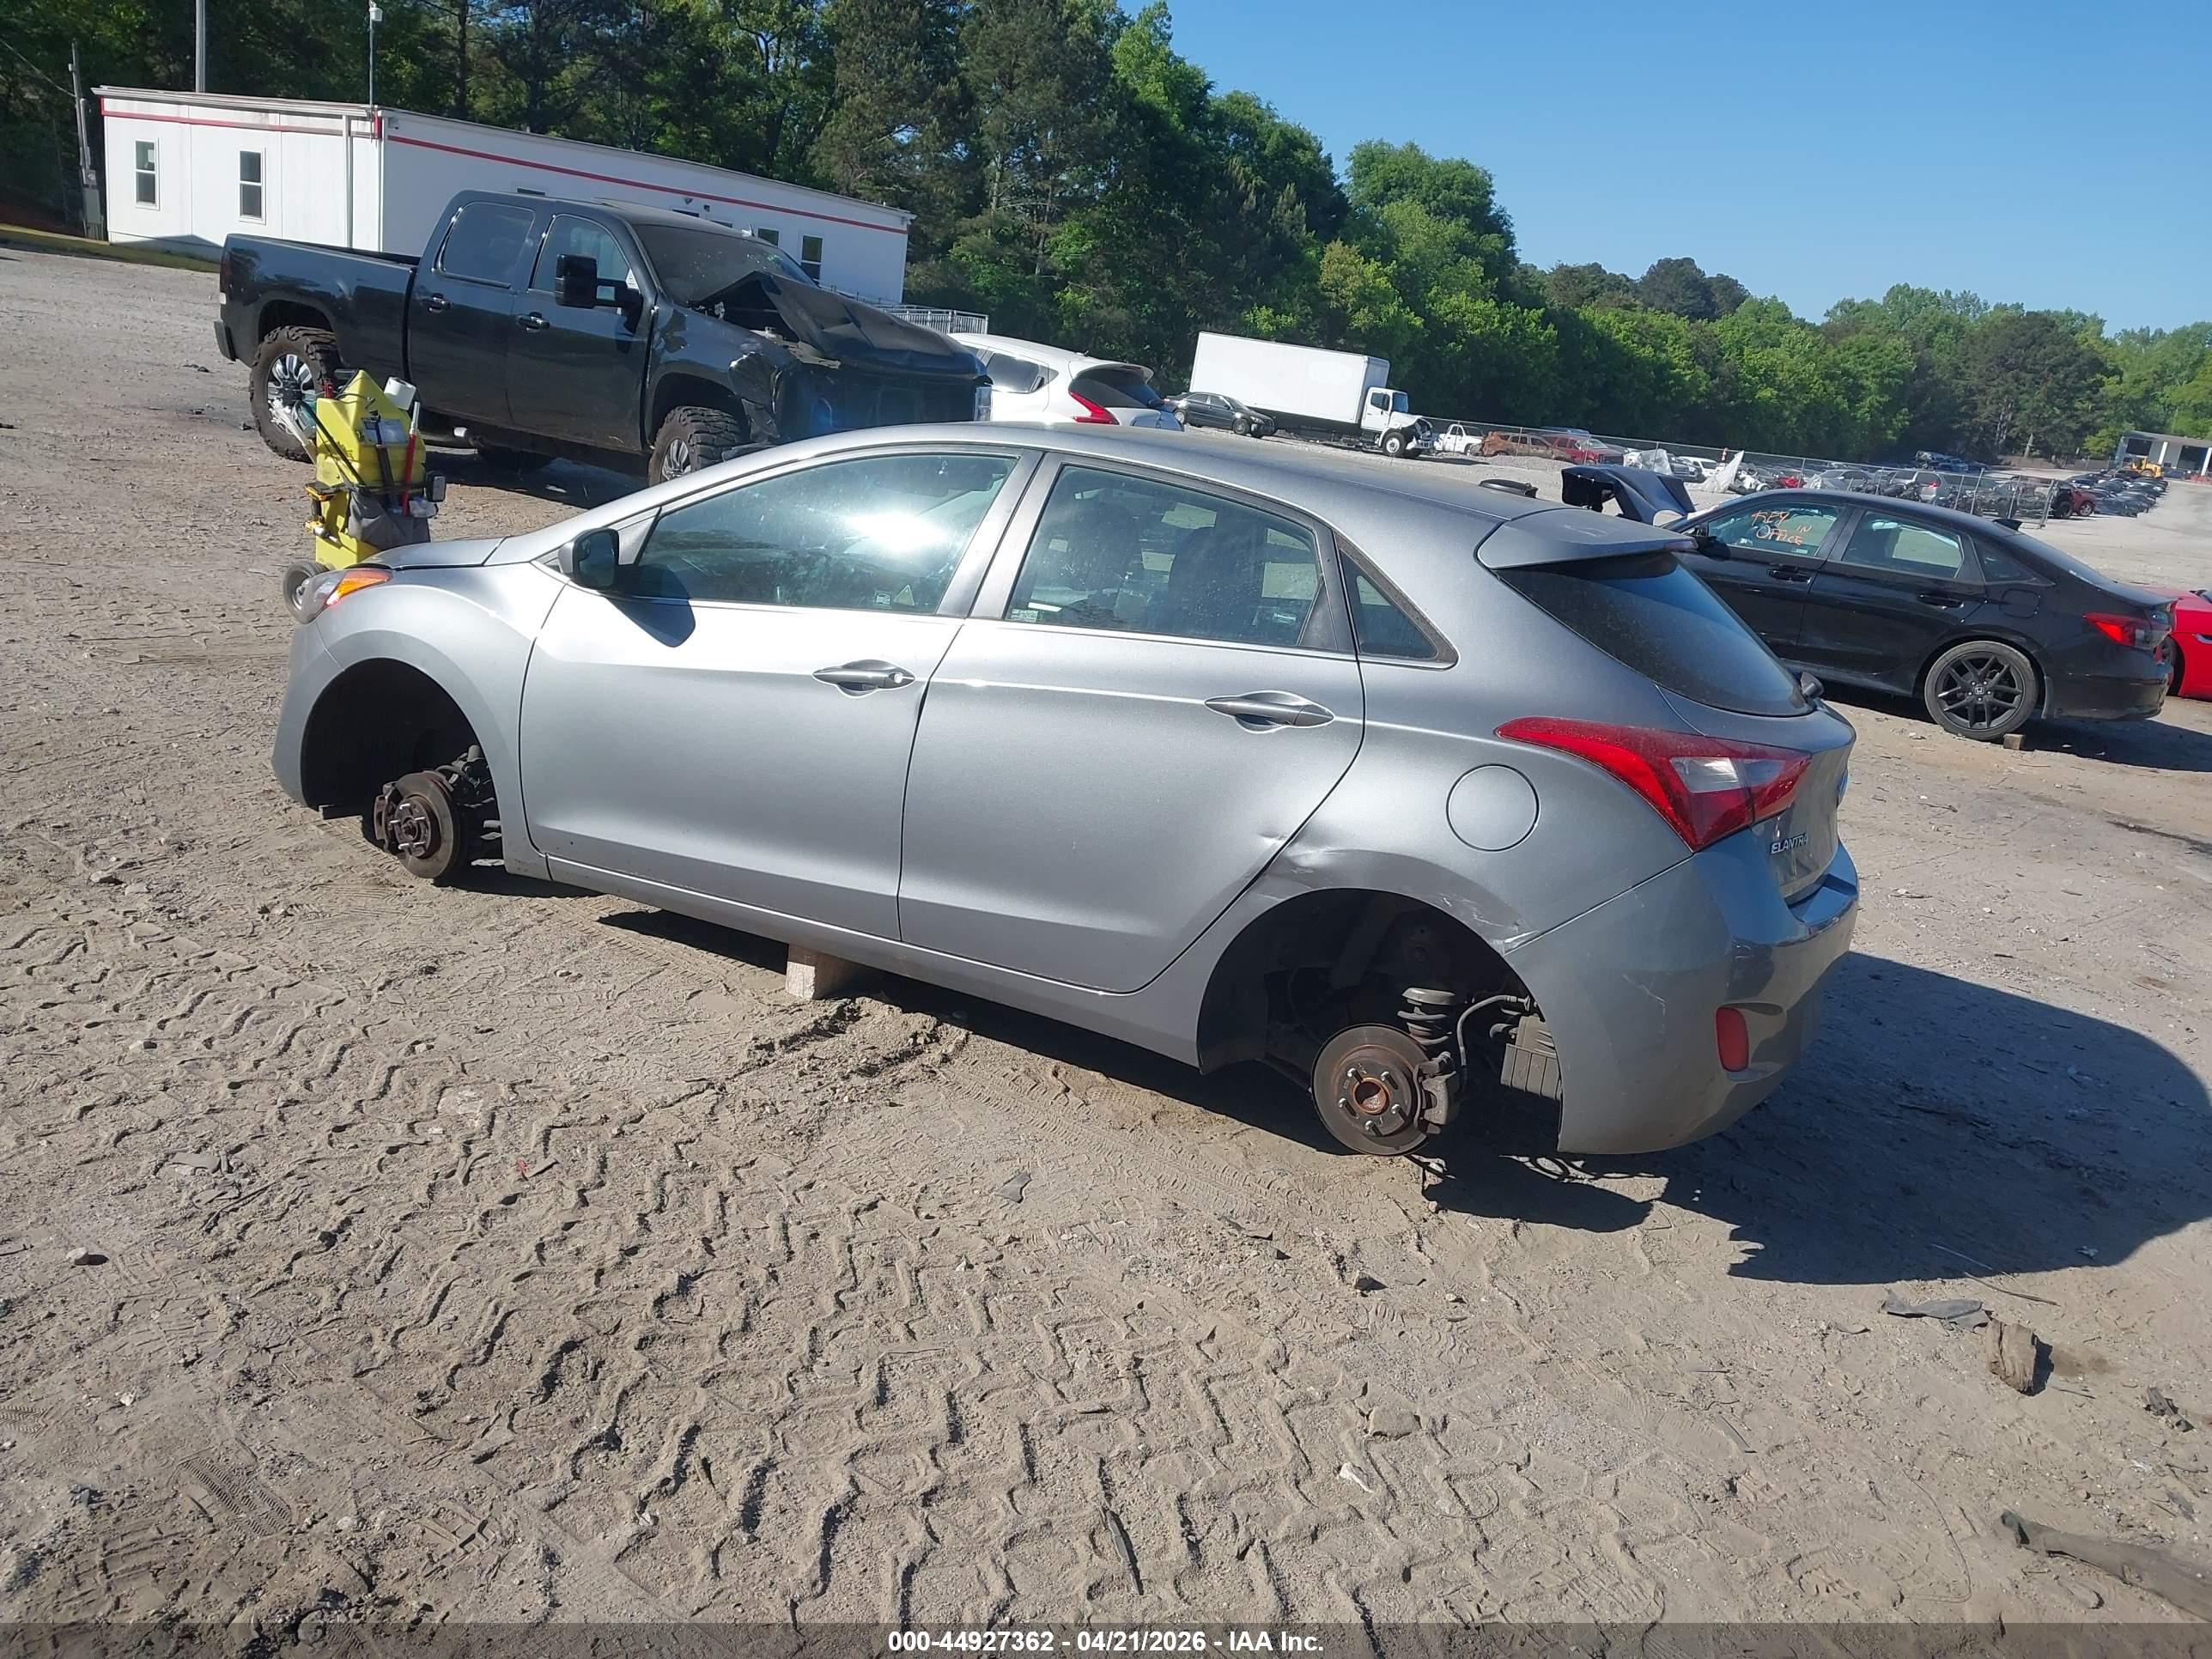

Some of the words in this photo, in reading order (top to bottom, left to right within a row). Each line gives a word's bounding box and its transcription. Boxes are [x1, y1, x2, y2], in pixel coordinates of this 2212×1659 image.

[1752, 510, 1790, 526] KEY
[1756, 525, 1802, 545] OFFICE
[1796, 525, 1812, 533] IN
[1771, 833, 1808, 854] ELANTRA
